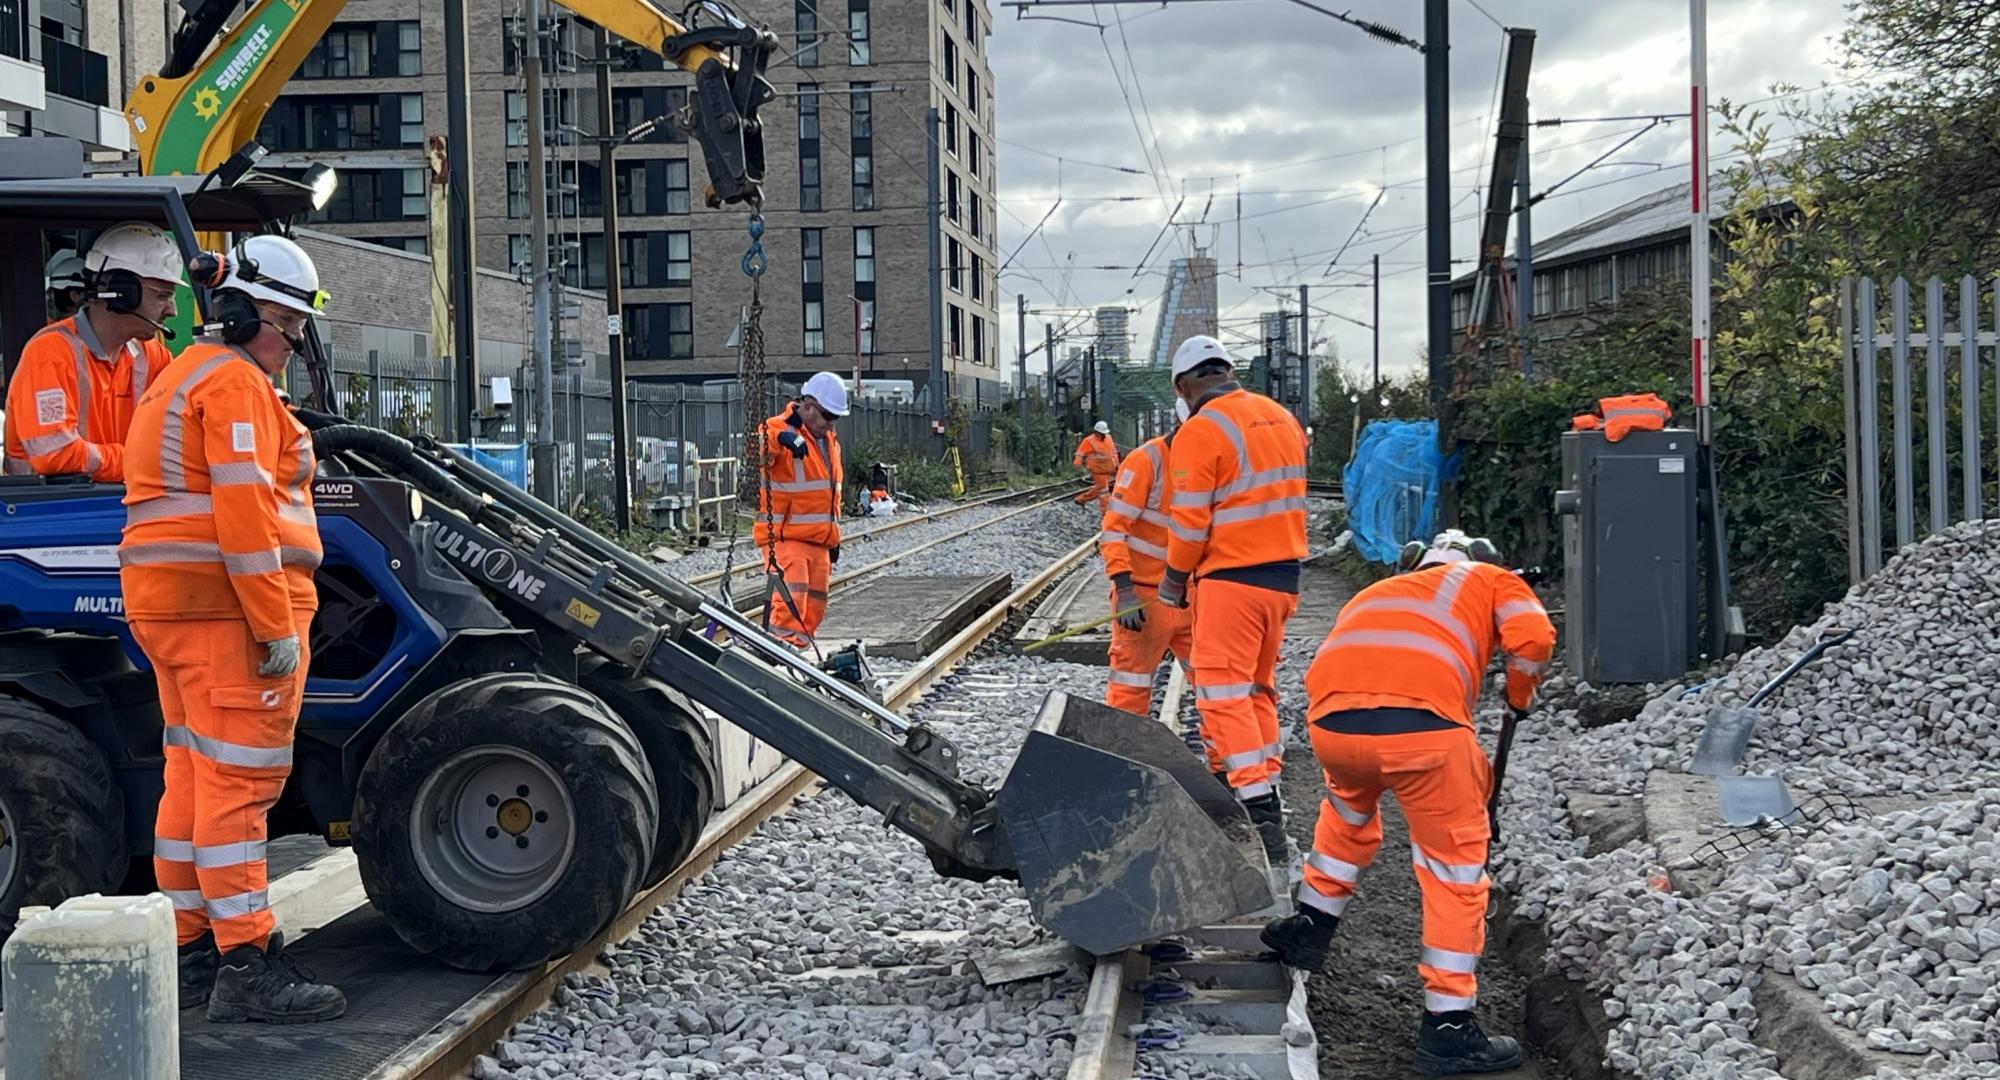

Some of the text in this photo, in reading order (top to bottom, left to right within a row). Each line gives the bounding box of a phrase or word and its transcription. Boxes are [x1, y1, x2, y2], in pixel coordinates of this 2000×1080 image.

[215, 23, 270, 91] SUNBELT
[230, 43, 269, 88] RENTALS
[315, 483, 353, 494] 4WD
[74, 596, 123, 613] MULTI
